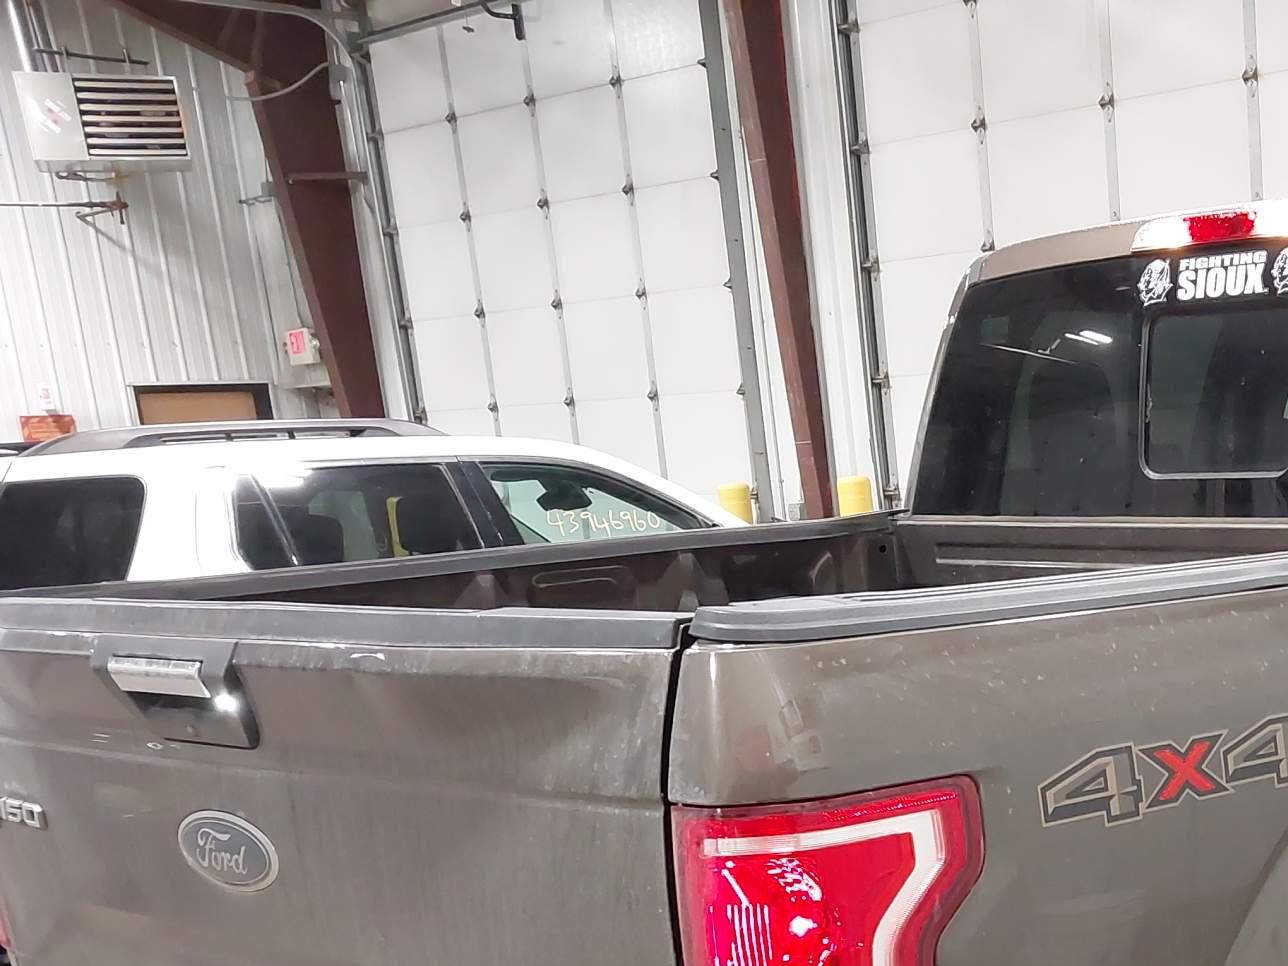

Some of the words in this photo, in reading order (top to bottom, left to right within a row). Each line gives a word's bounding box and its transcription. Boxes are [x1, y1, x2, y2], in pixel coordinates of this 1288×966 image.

[1179, 251, 1268, 271] FIGHTING
[546, 509, 661, 537] 43946960
[196, 827, 249, 875] Ford
